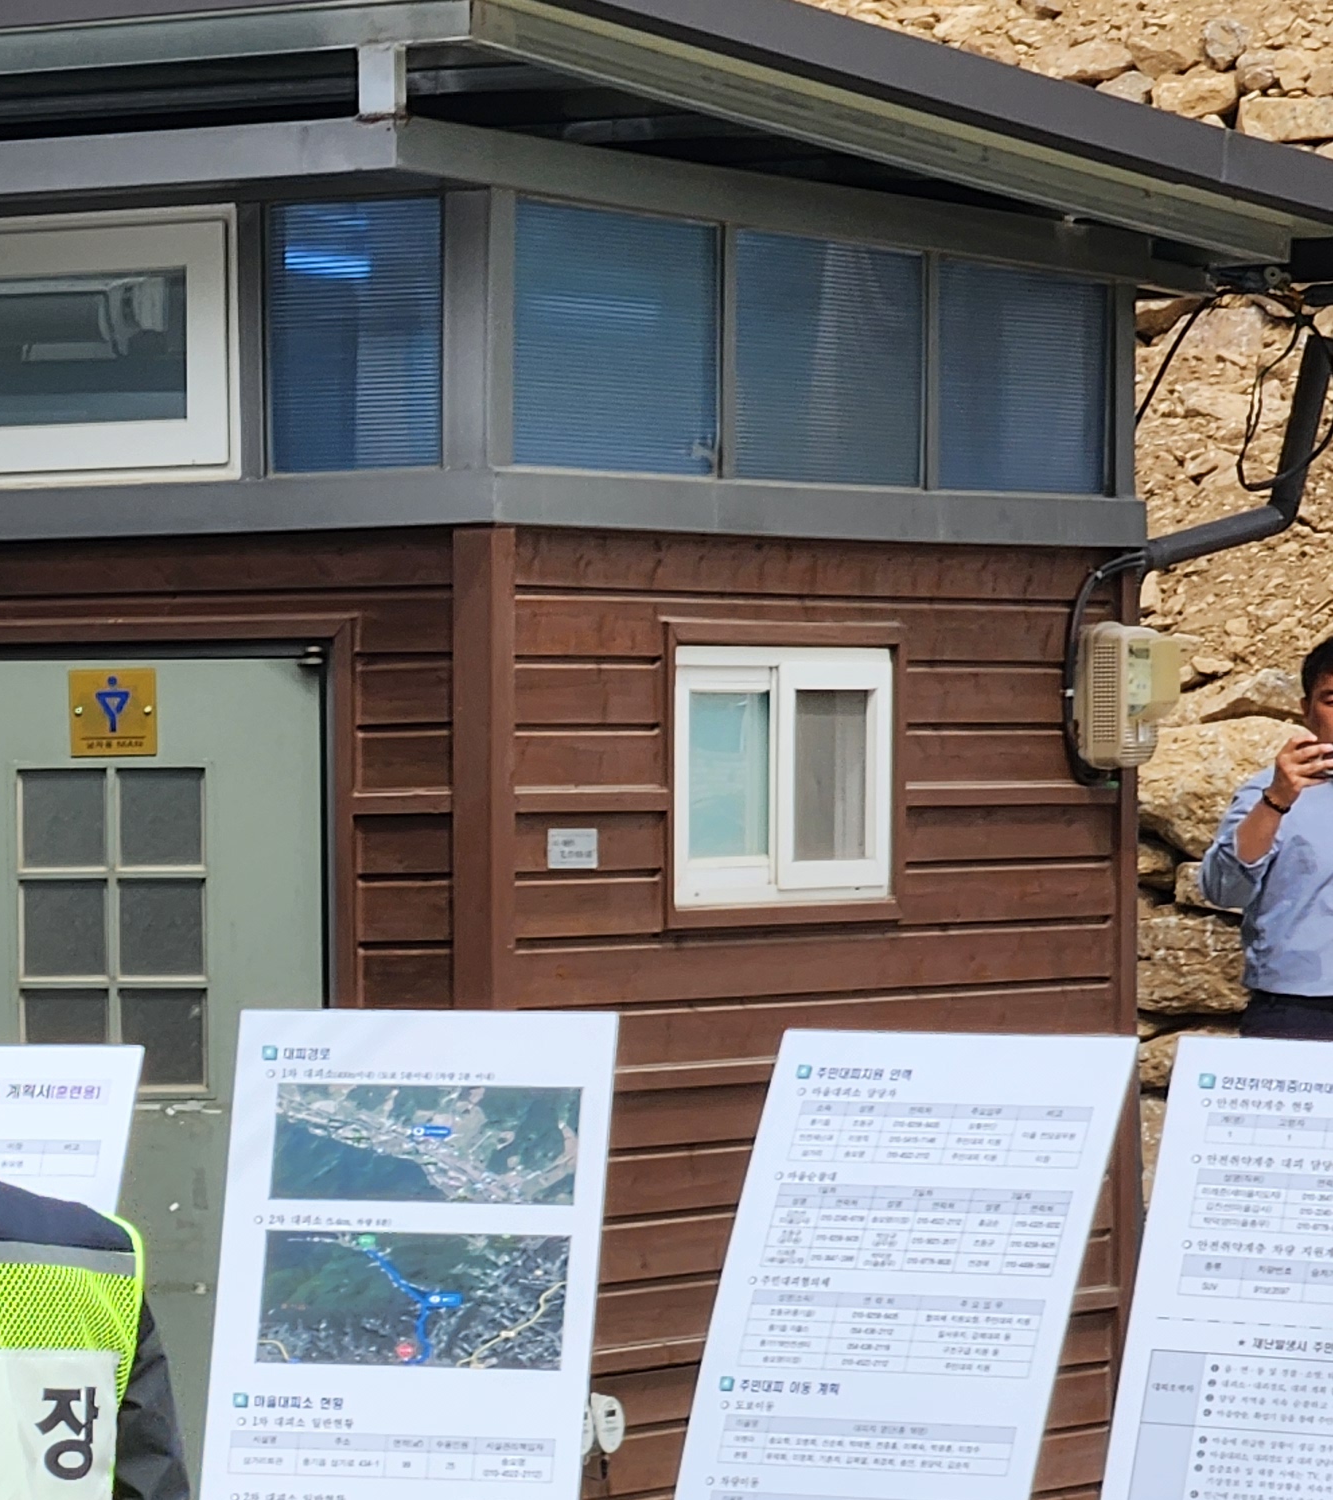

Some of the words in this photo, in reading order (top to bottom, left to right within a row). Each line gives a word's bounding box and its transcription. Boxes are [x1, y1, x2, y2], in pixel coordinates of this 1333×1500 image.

[817, 1066, 885, 1081] 주민대피지원
[739, 1379, 785, 1394] 주민대피
[789, 1380, 813, 1395] 이동
[253, 1395, 313, 1410] 마을대피소
[35, 1387, 100, 1480] 장
